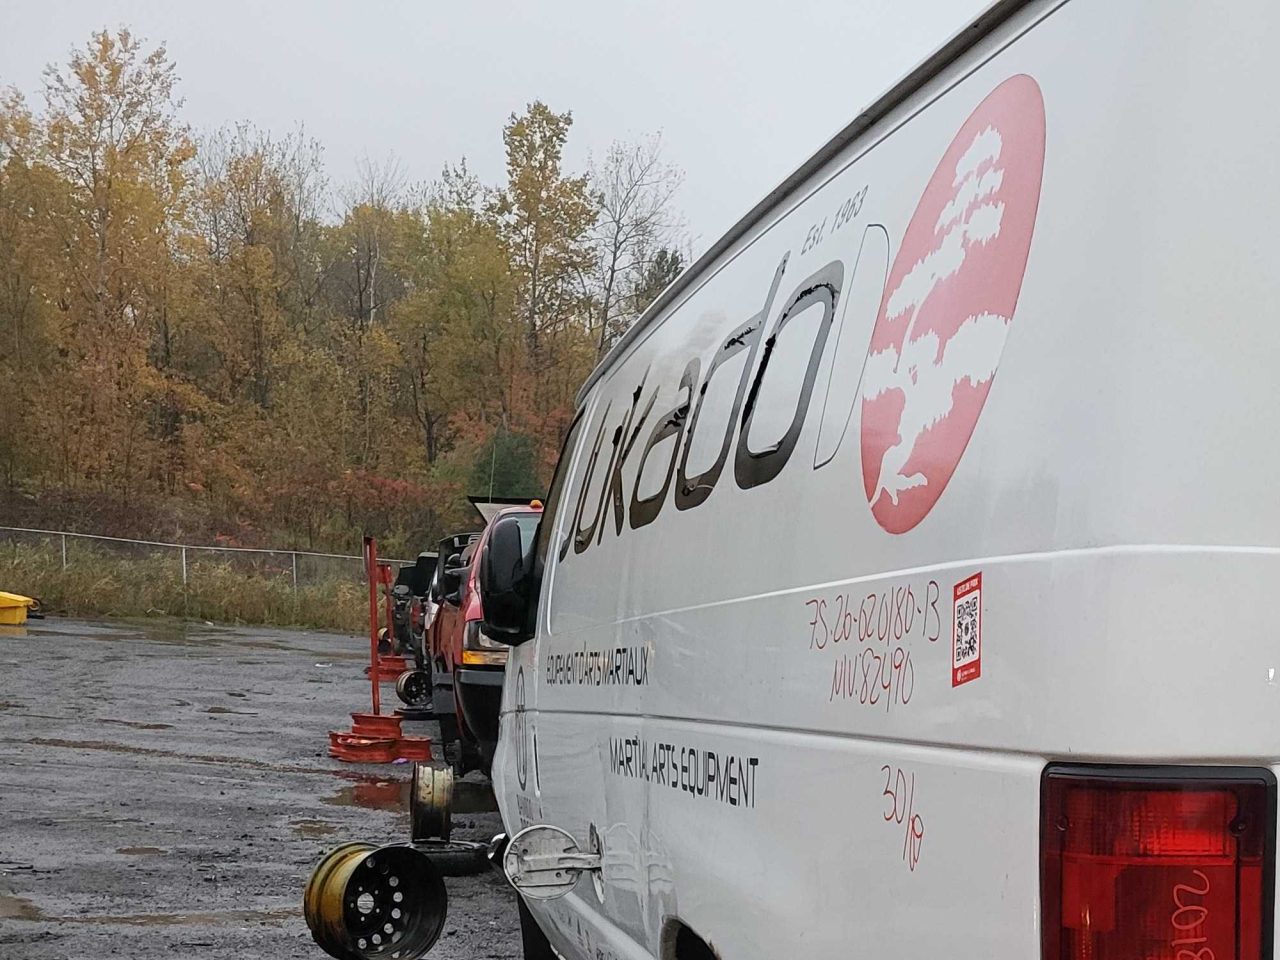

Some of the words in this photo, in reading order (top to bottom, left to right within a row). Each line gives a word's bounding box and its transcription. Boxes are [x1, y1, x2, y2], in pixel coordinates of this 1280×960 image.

[800, 216, 827, 256] Est.
[830, 184, 869, 235] 1963
[651, 742, 679, 789] ARTS
[681, 746, 759, 809] EQUIPMENT
